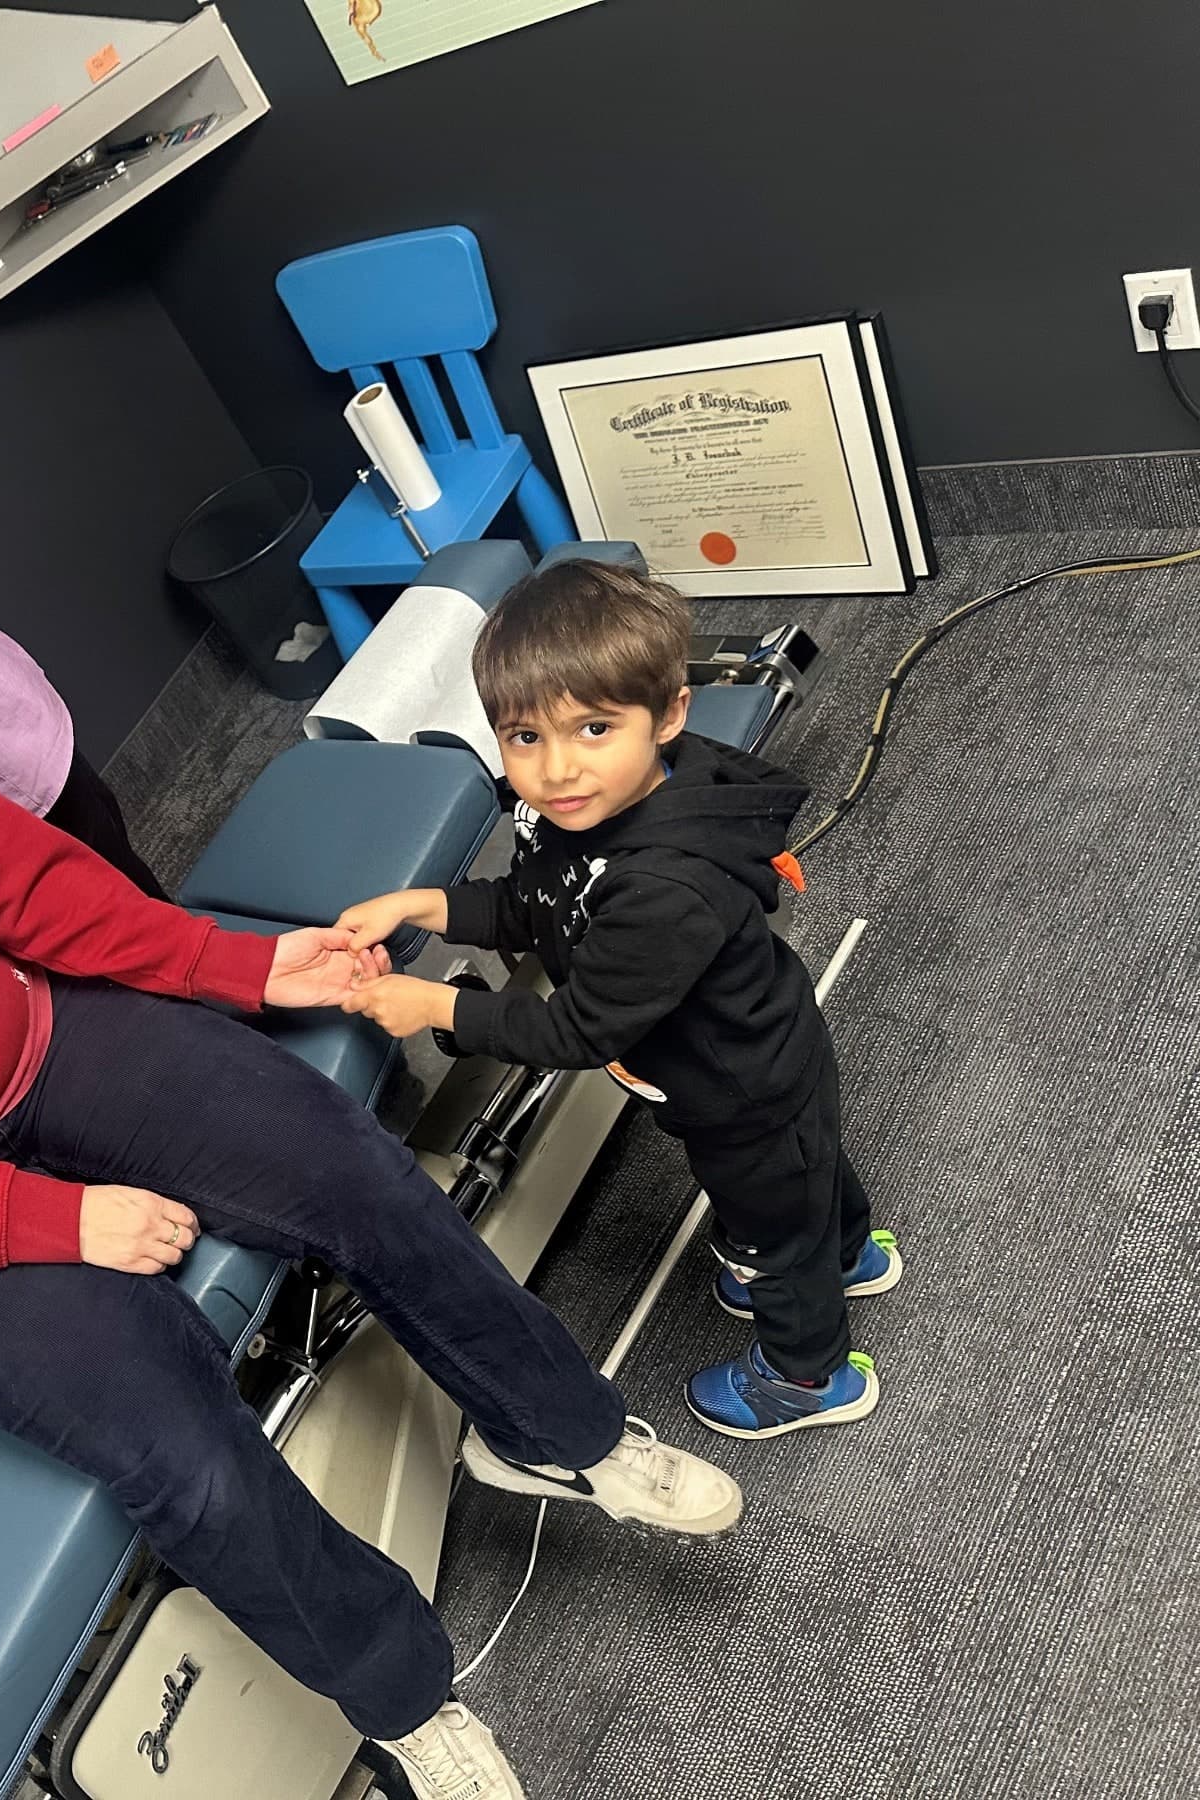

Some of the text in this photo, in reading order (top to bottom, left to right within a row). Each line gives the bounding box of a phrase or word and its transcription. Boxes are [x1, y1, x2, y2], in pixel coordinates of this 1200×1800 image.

[609, 392, 791, 432] Certificate of Registration.
